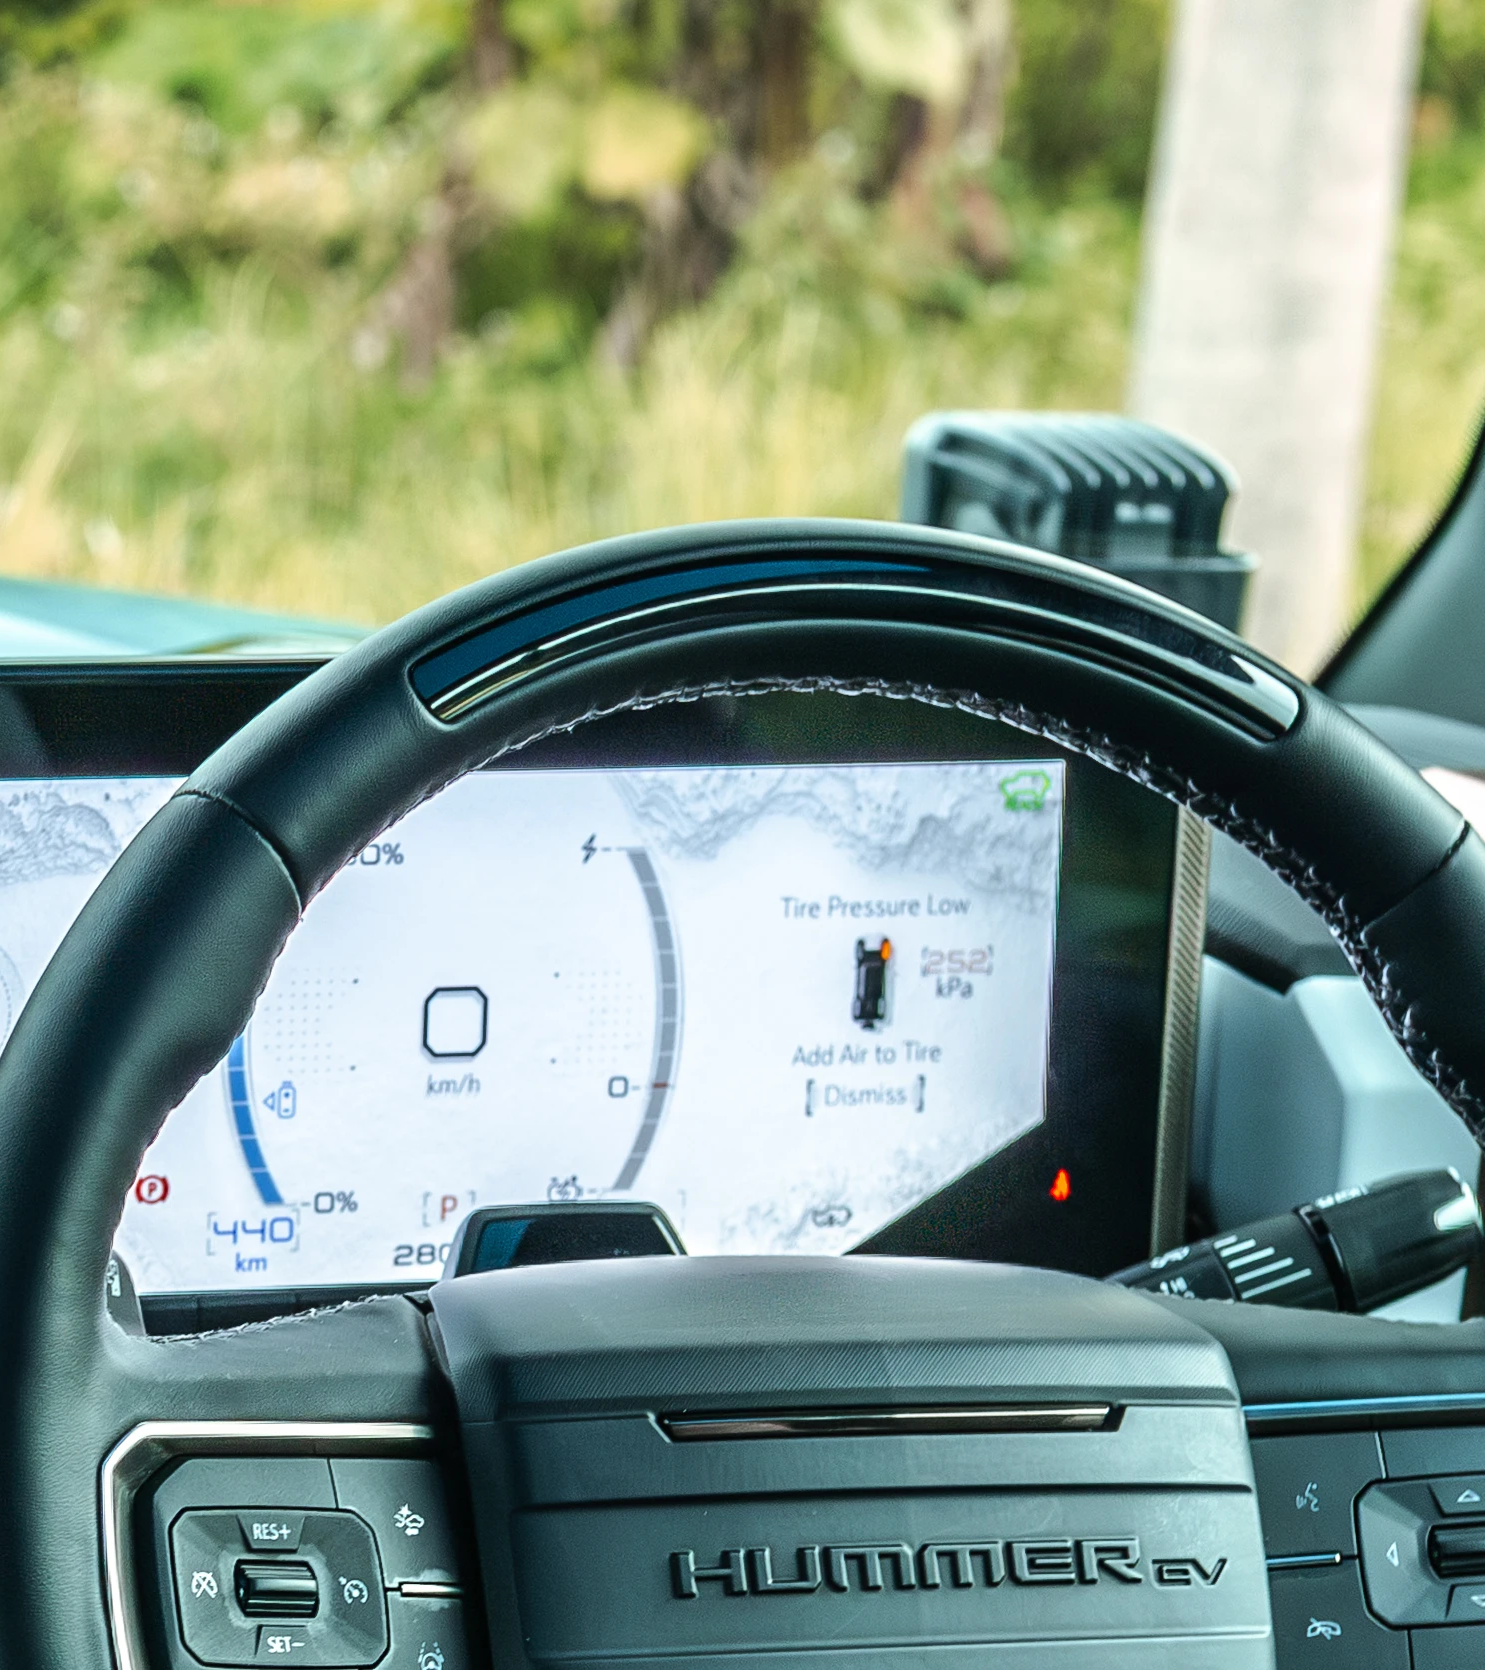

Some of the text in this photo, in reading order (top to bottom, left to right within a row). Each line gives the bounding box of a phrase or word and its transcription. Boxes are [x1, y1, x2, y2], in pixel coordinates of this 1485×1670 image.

[346, 842, 405, 867] 0%
[781, 894, 972, 919] Tire Pressure Low
[936, 976, 973, 999] kPa
[422, 986, 489, 1058] 0
[791, 1040, 942, 1067] Add Air to Tire
[425, 1074, 482, 1096] km/h
[824, 1084, 908, 1107] Dismiss
[313, 1191, 359, 1214] 0%
[439, 1195, 459, 1221] P
[212, 1216, 295, 1244] 440
[234, 1253, 268, 1272] km
[670, 1535, 1229, 1601] HUMMER EV
